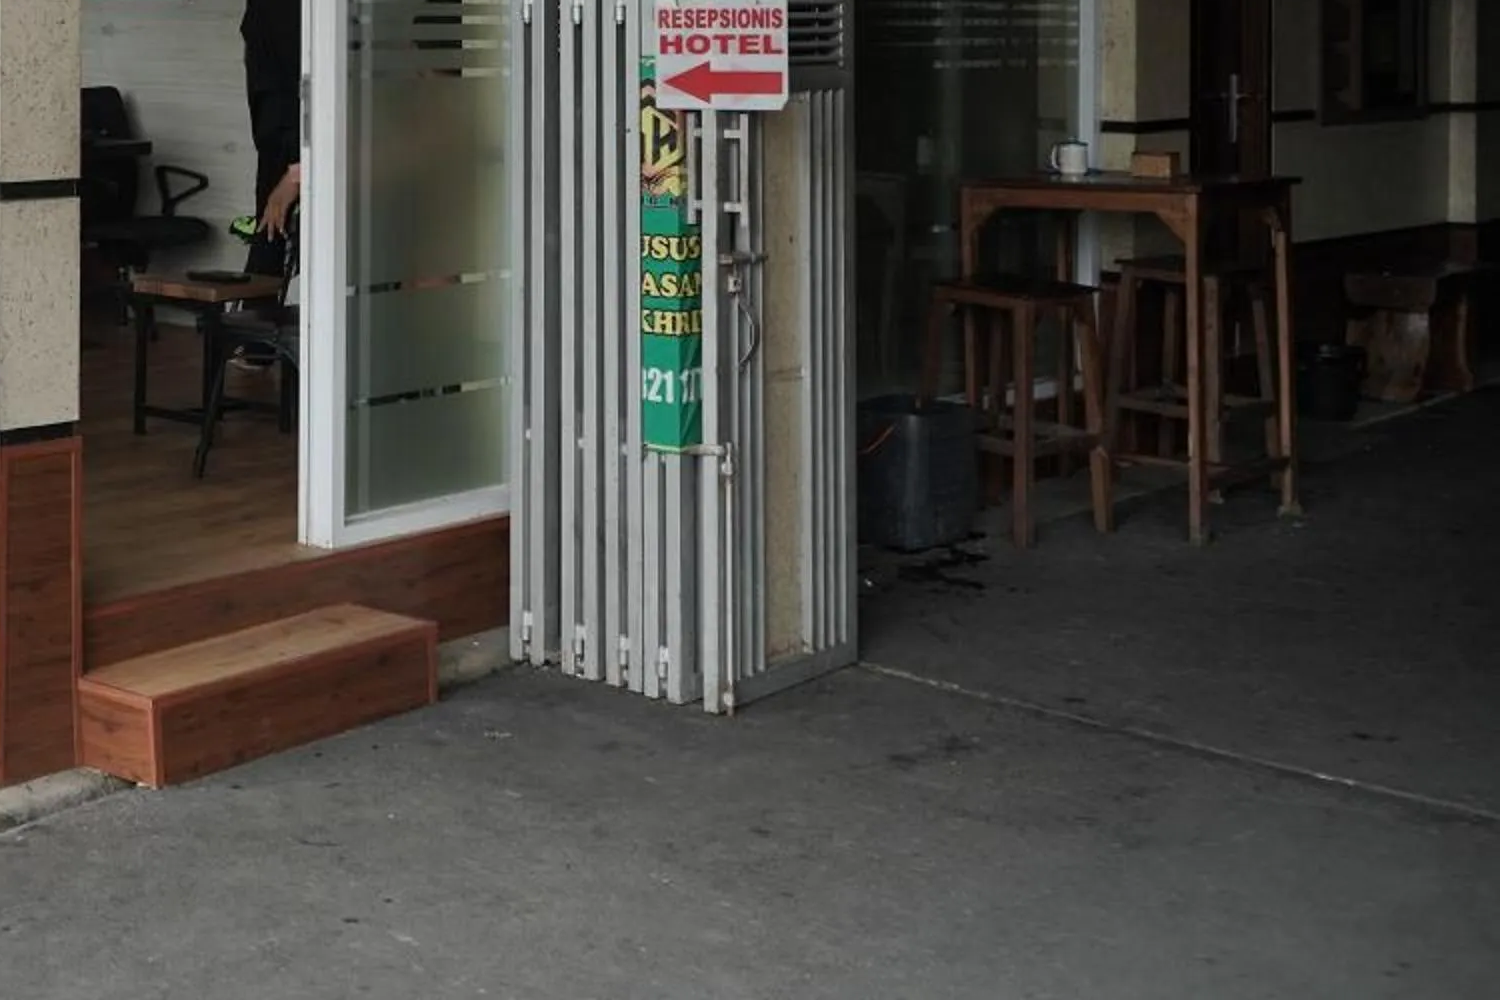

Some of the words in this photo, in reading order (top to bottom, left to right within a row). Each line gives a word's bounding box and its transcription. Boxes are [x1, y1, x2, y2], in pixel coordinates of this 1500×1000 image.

[658, 8, 784, 29] RESEPSIONIS
[659, 33, 785, 55] HOTEL
[642, 367, 674, 404] 21
